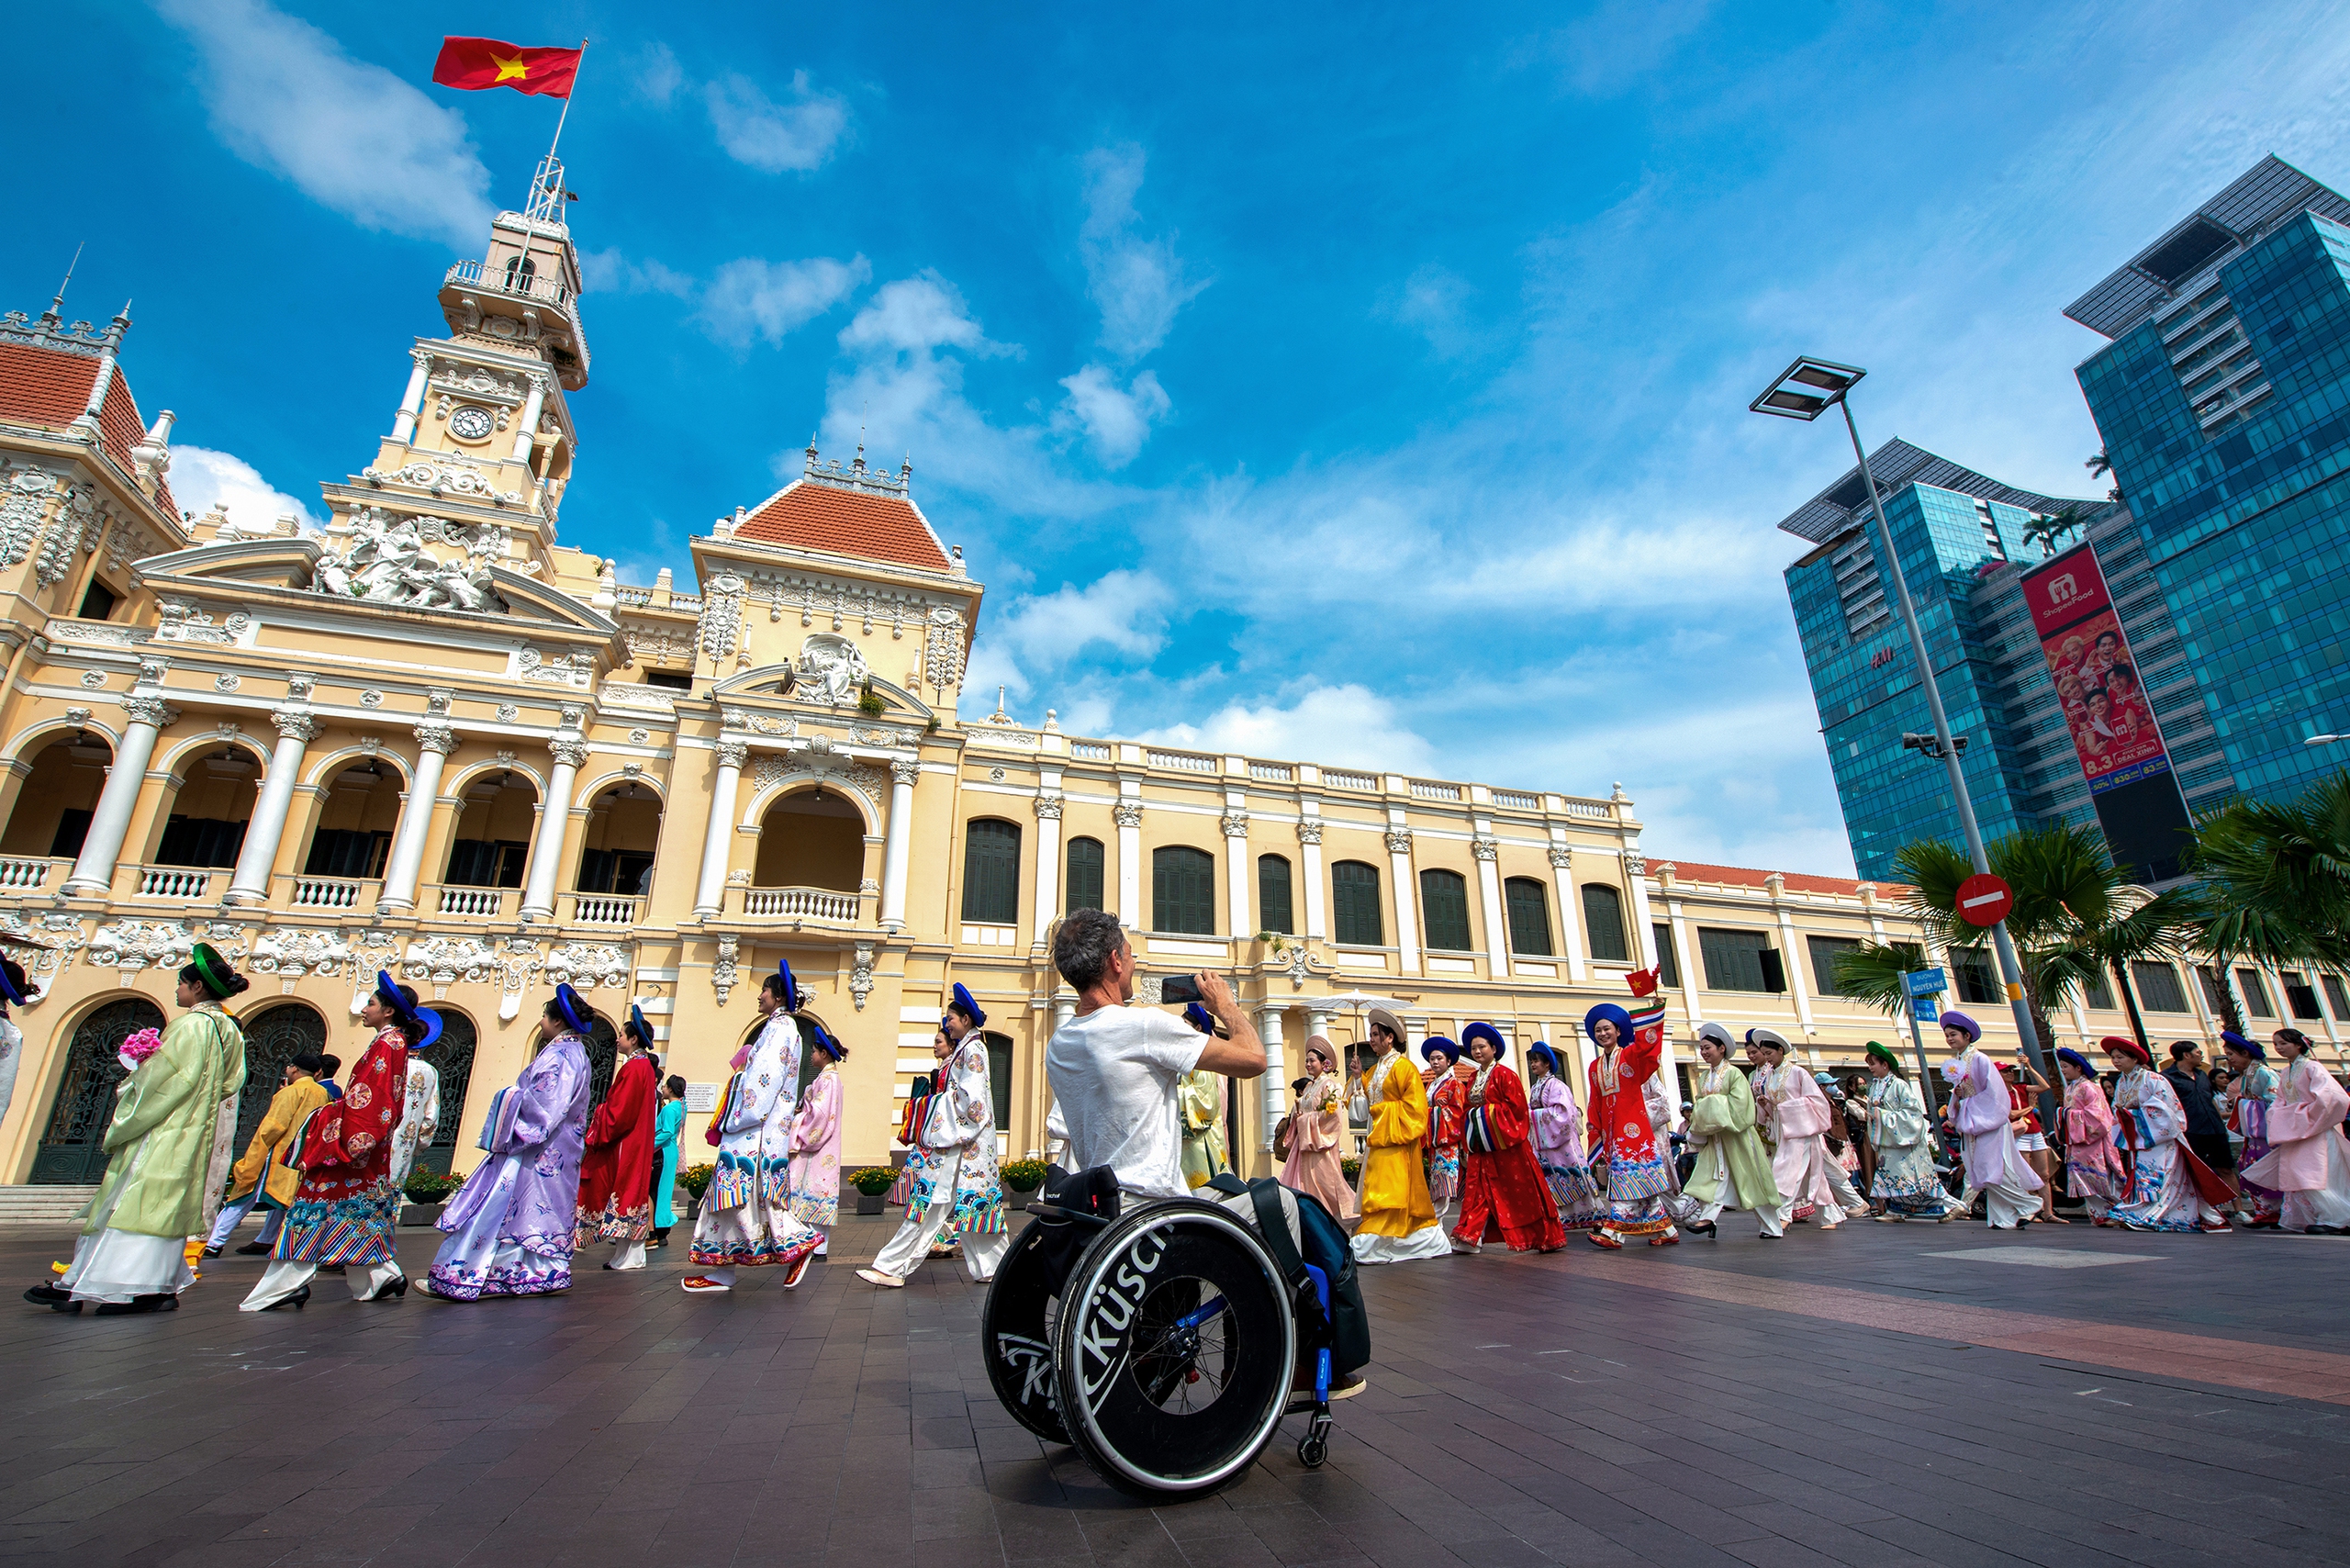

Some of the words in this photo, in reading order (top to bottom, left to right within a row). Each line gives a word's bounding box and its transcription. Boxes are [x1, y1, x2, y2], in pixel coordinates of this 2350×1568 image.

[2042, 588, 2094, 619] ShopeeFood
[2117, 753, 2136, 764] DEAL
[2136, 745, 2155, 756] XINH
[2085, 755, 2113, 775] 8.3
